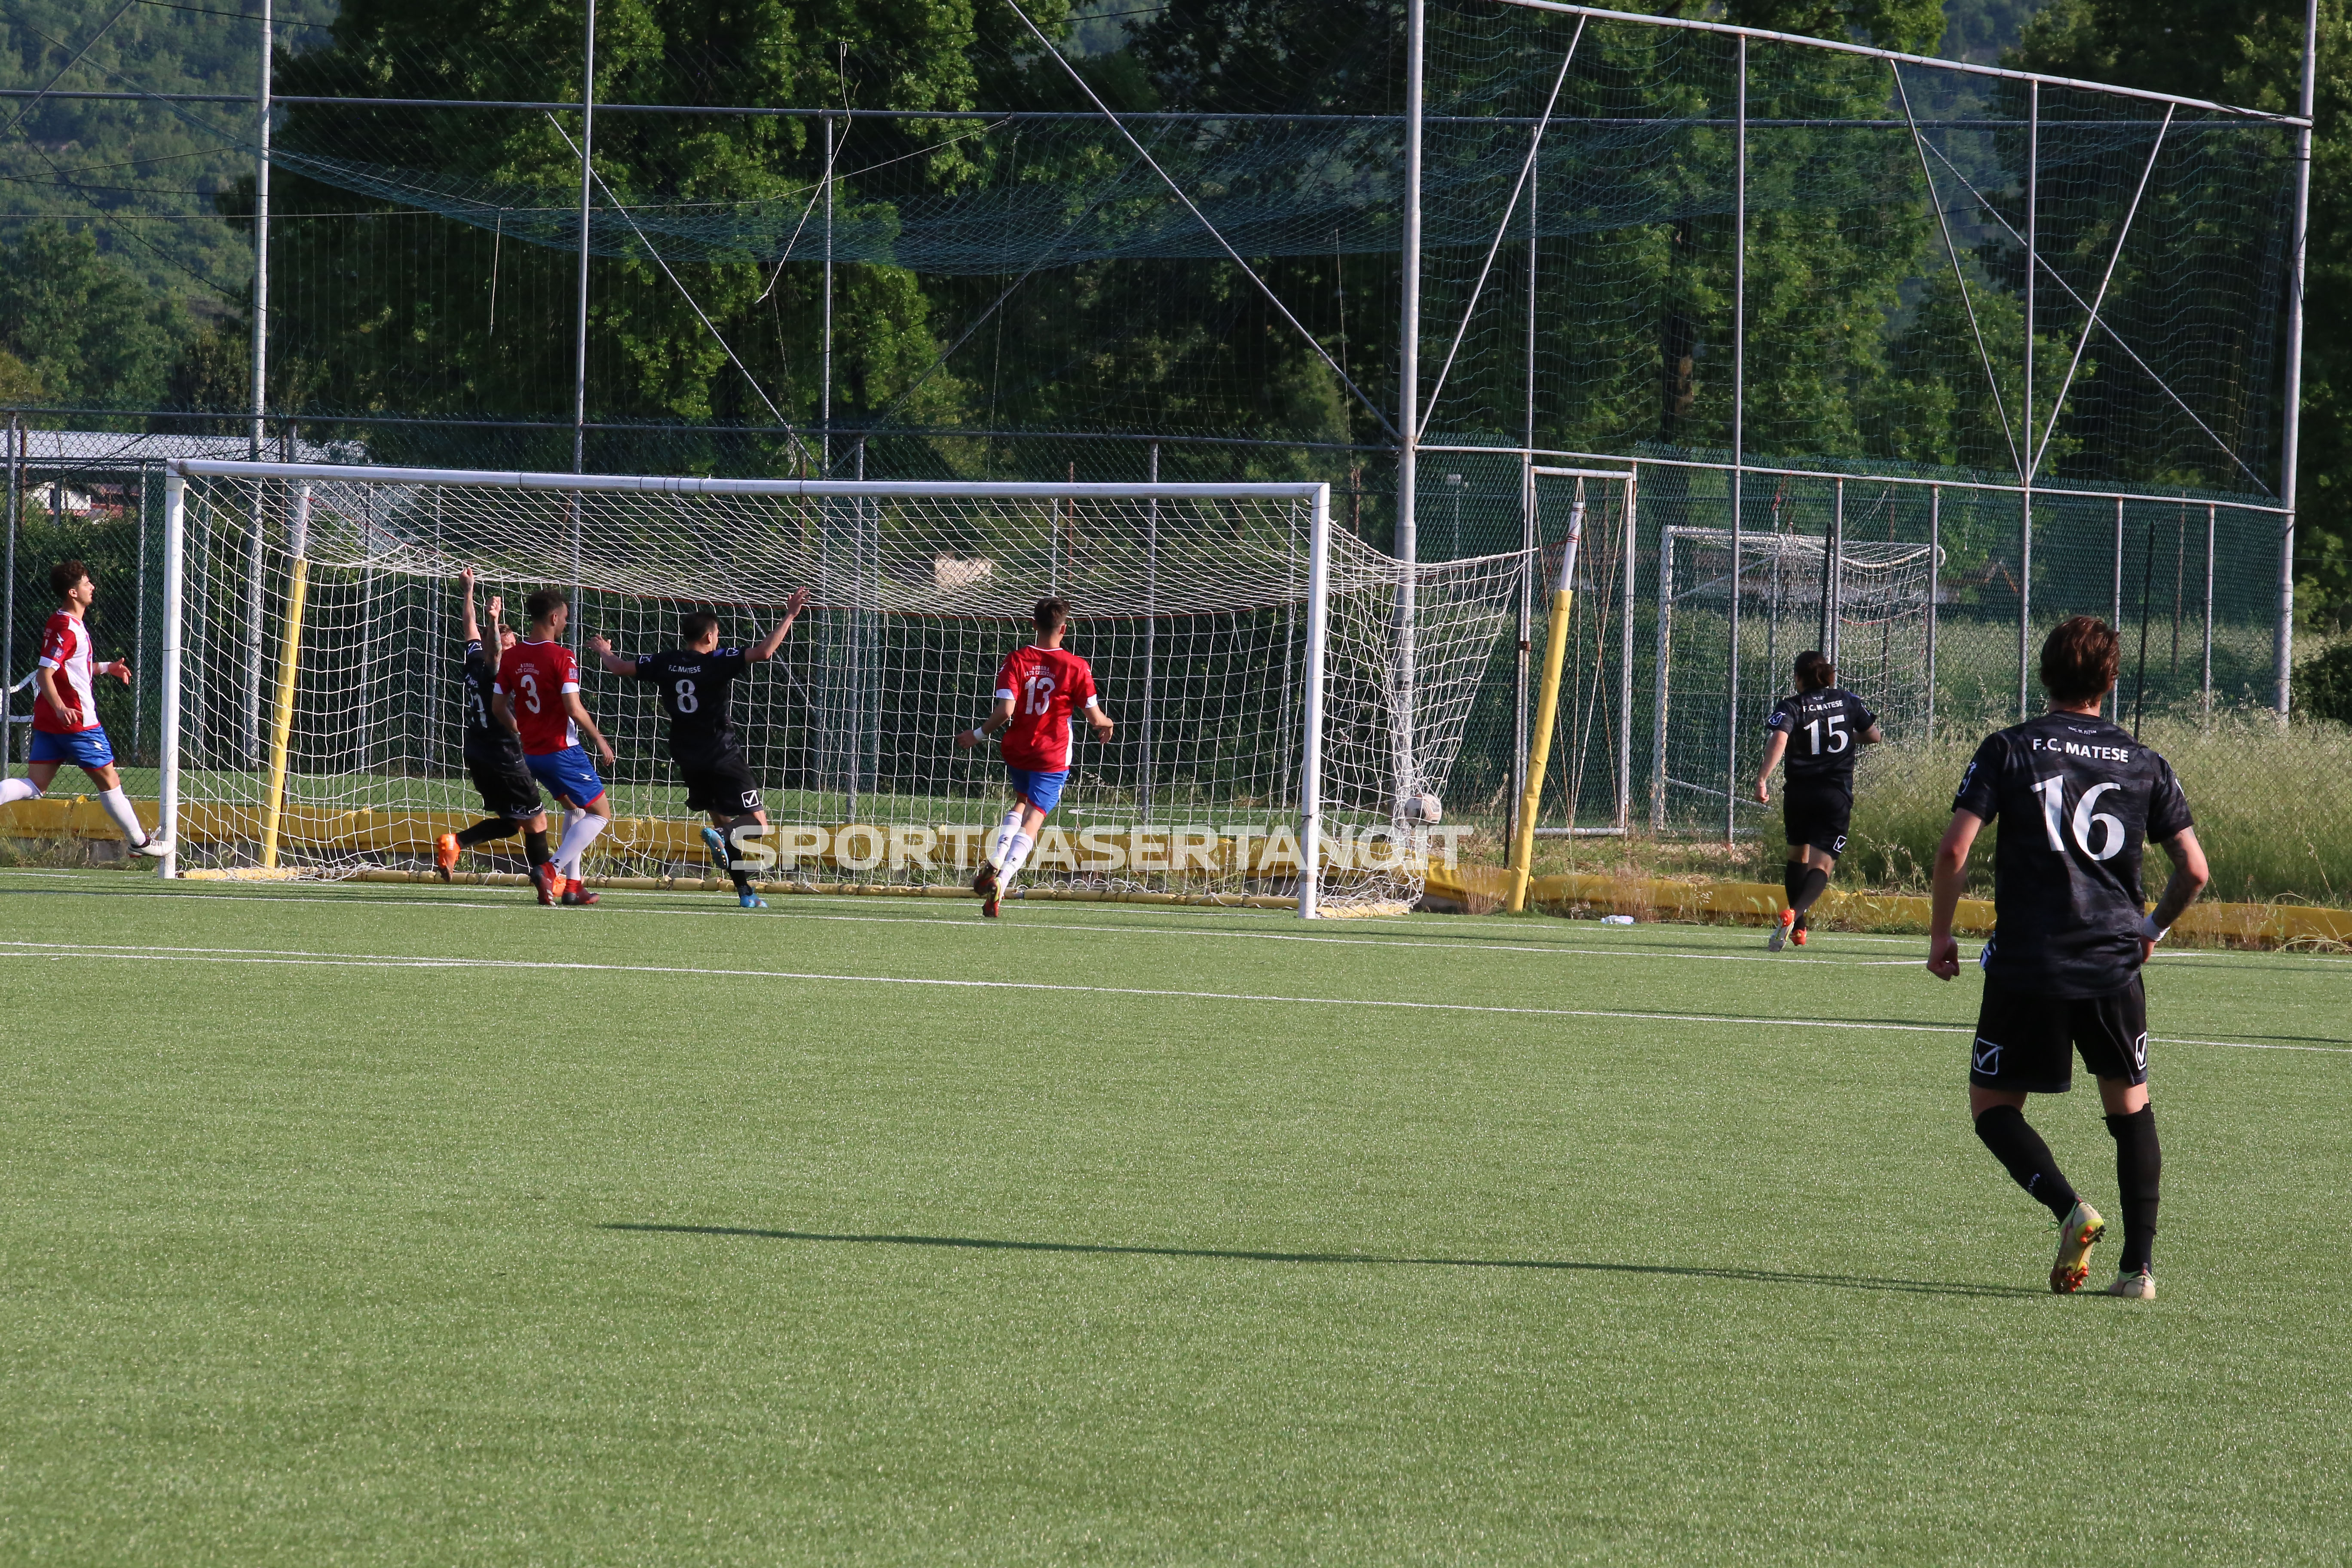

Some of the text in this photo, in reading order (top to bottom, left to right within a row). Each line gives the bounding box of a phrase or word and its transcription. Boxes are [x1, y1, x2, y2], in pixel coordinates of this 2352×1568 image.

[521, 674, 540, 714] 3
[676, 679, 698, 713] 8
[1025, 676, 1056, 716] 13
[1817, 700, 1844, 711] MATESE
[1804, 714, 1849, 755] 15
[2033, 738, 2128, 763] F.C. MATESE
[2030, 774, 2125, 861] 16
